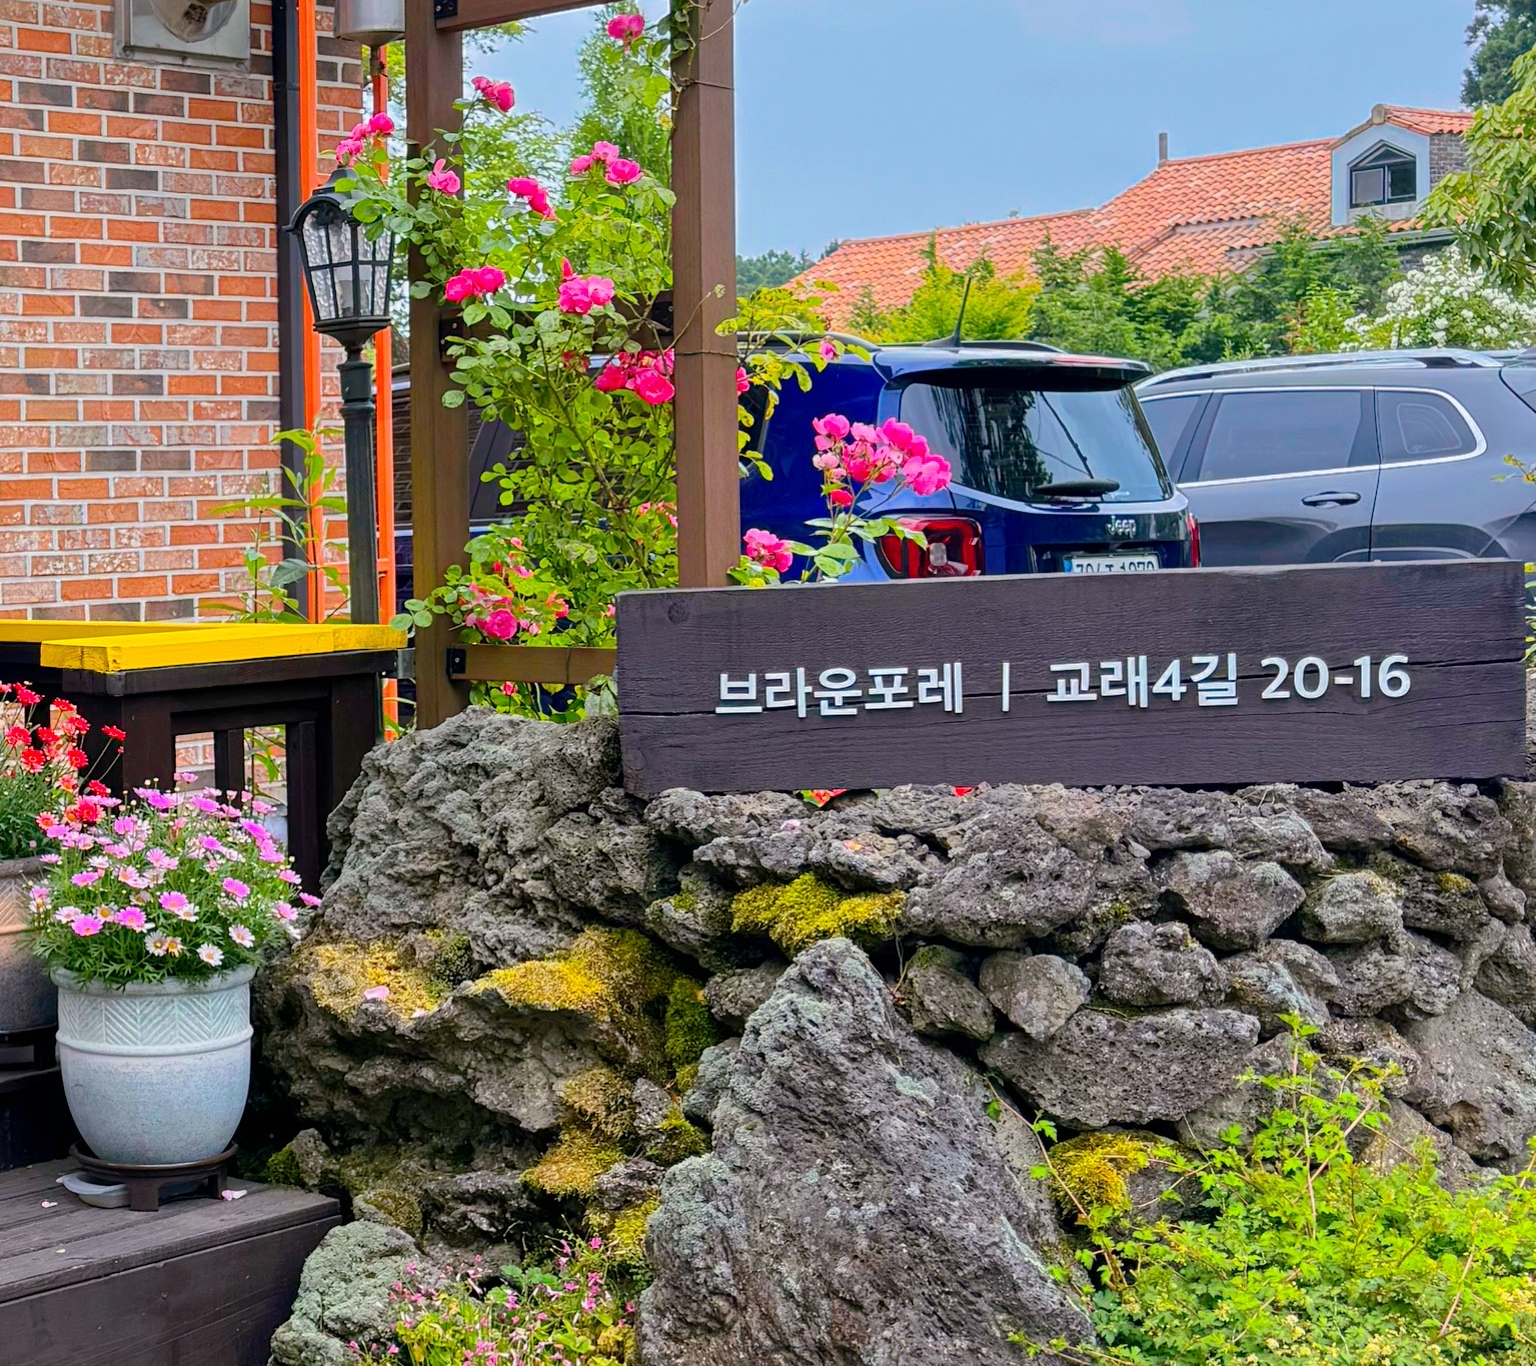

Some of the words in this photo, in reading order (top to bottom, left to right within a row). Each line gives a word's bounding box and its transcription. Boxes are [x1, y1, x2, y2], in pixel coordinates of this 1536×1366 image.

[1106, 515, 1137, 539] Jeep
[715, 662, 963, 718] 브라운포레
[1046, 653, 1239, 708] 교래4길
[1260, 655, 1412, 699] 20-16
